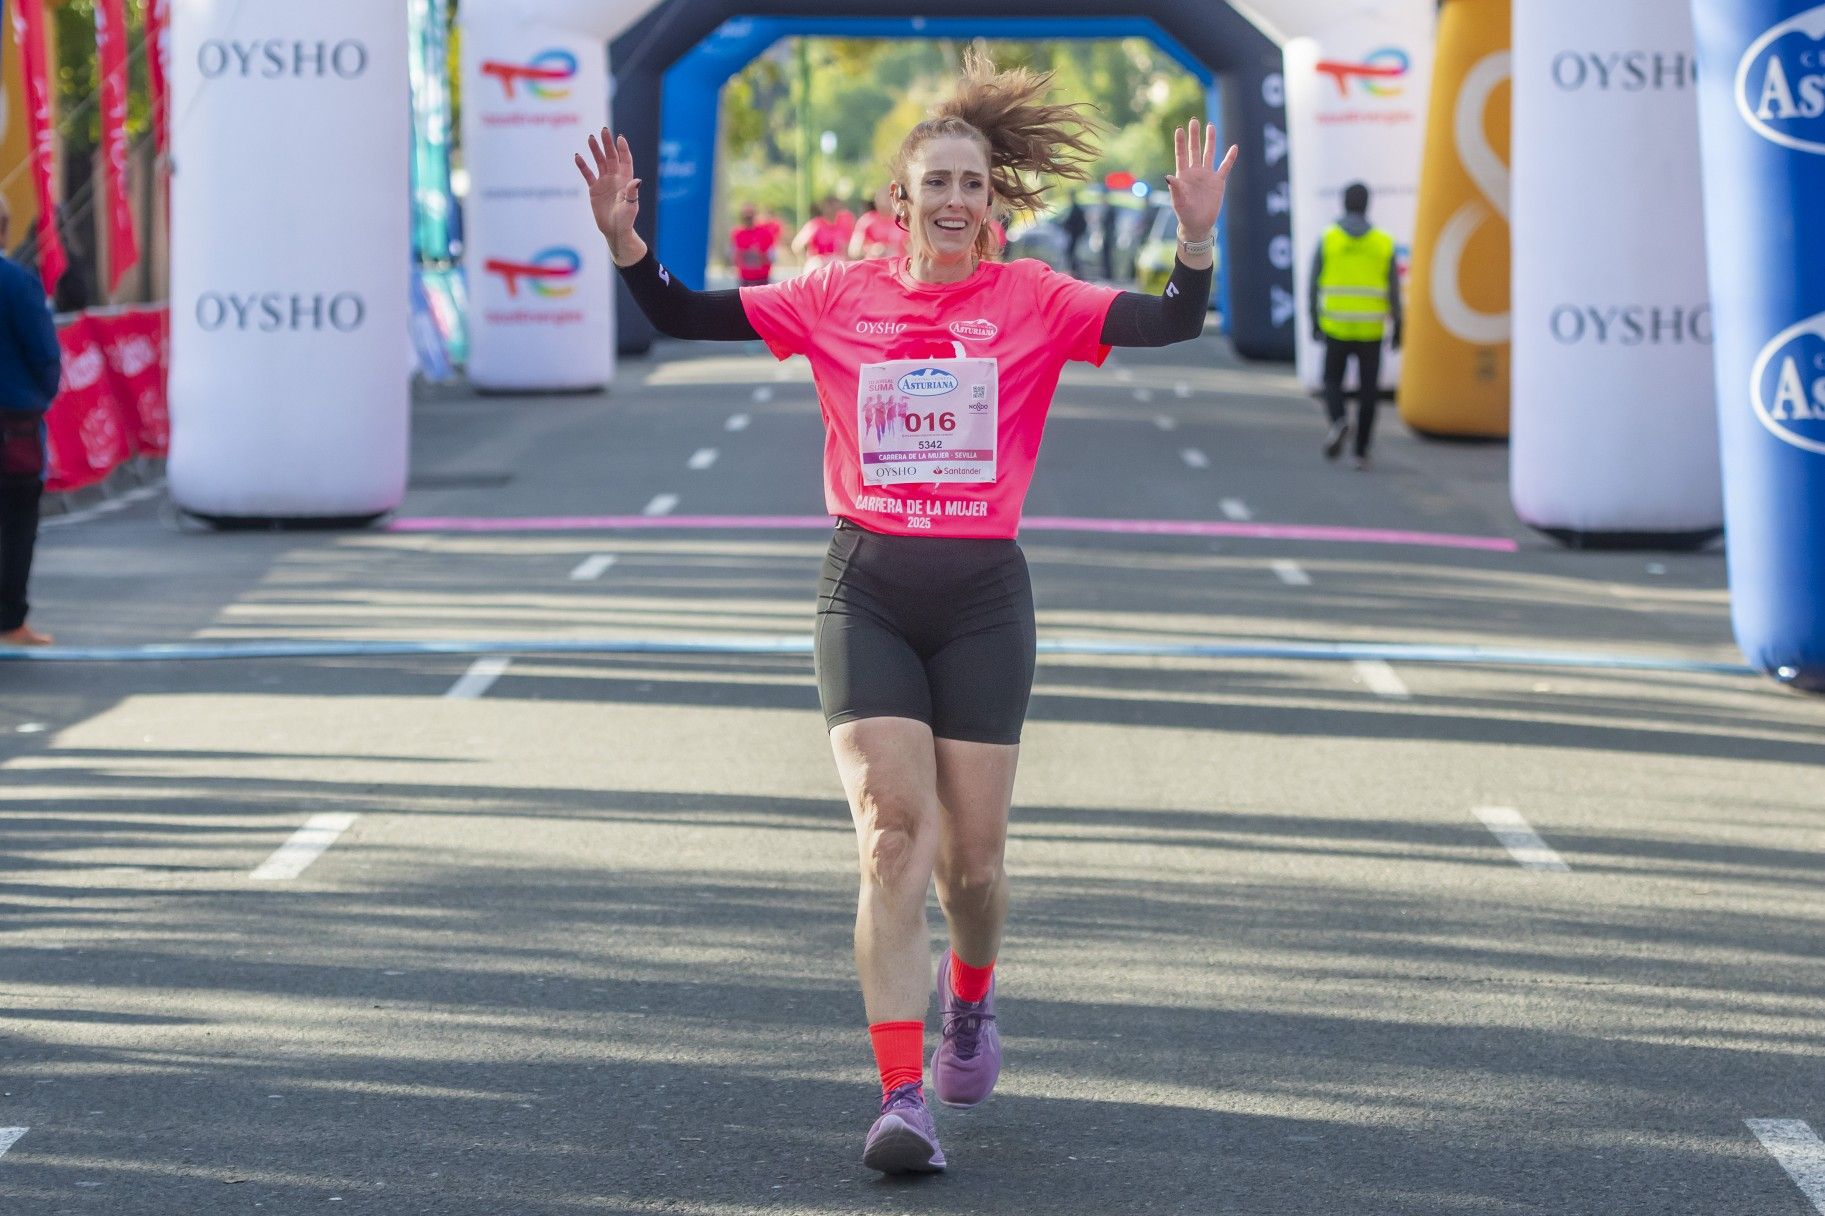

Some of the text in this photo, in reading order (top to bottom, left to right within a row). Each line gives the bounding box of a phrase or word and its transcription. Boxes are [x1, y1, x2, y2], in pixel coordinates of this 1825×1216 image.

[198, 38, 368, 80] OYSHO
[1551, 50, 1697, 91] OYSH
[195, 290, 366, 333] OYSHO
[856, 321, 908, 334] OYSHO
[868, 383, 894, 392] SUMA
[902, 379, 955, 390] ASTURIANA
[904, 412, 956, 433] 016
[918, 440, 943, 450] 5342
[878, 453, 907, 461] CARRERA
[876, 466, 917, 477] OYSHO
[944, 467, 981, 475] Santander
[854, 495, 988, 516] CARRERA DE LA MUJER
[907, 516, 931, 529] 2025
